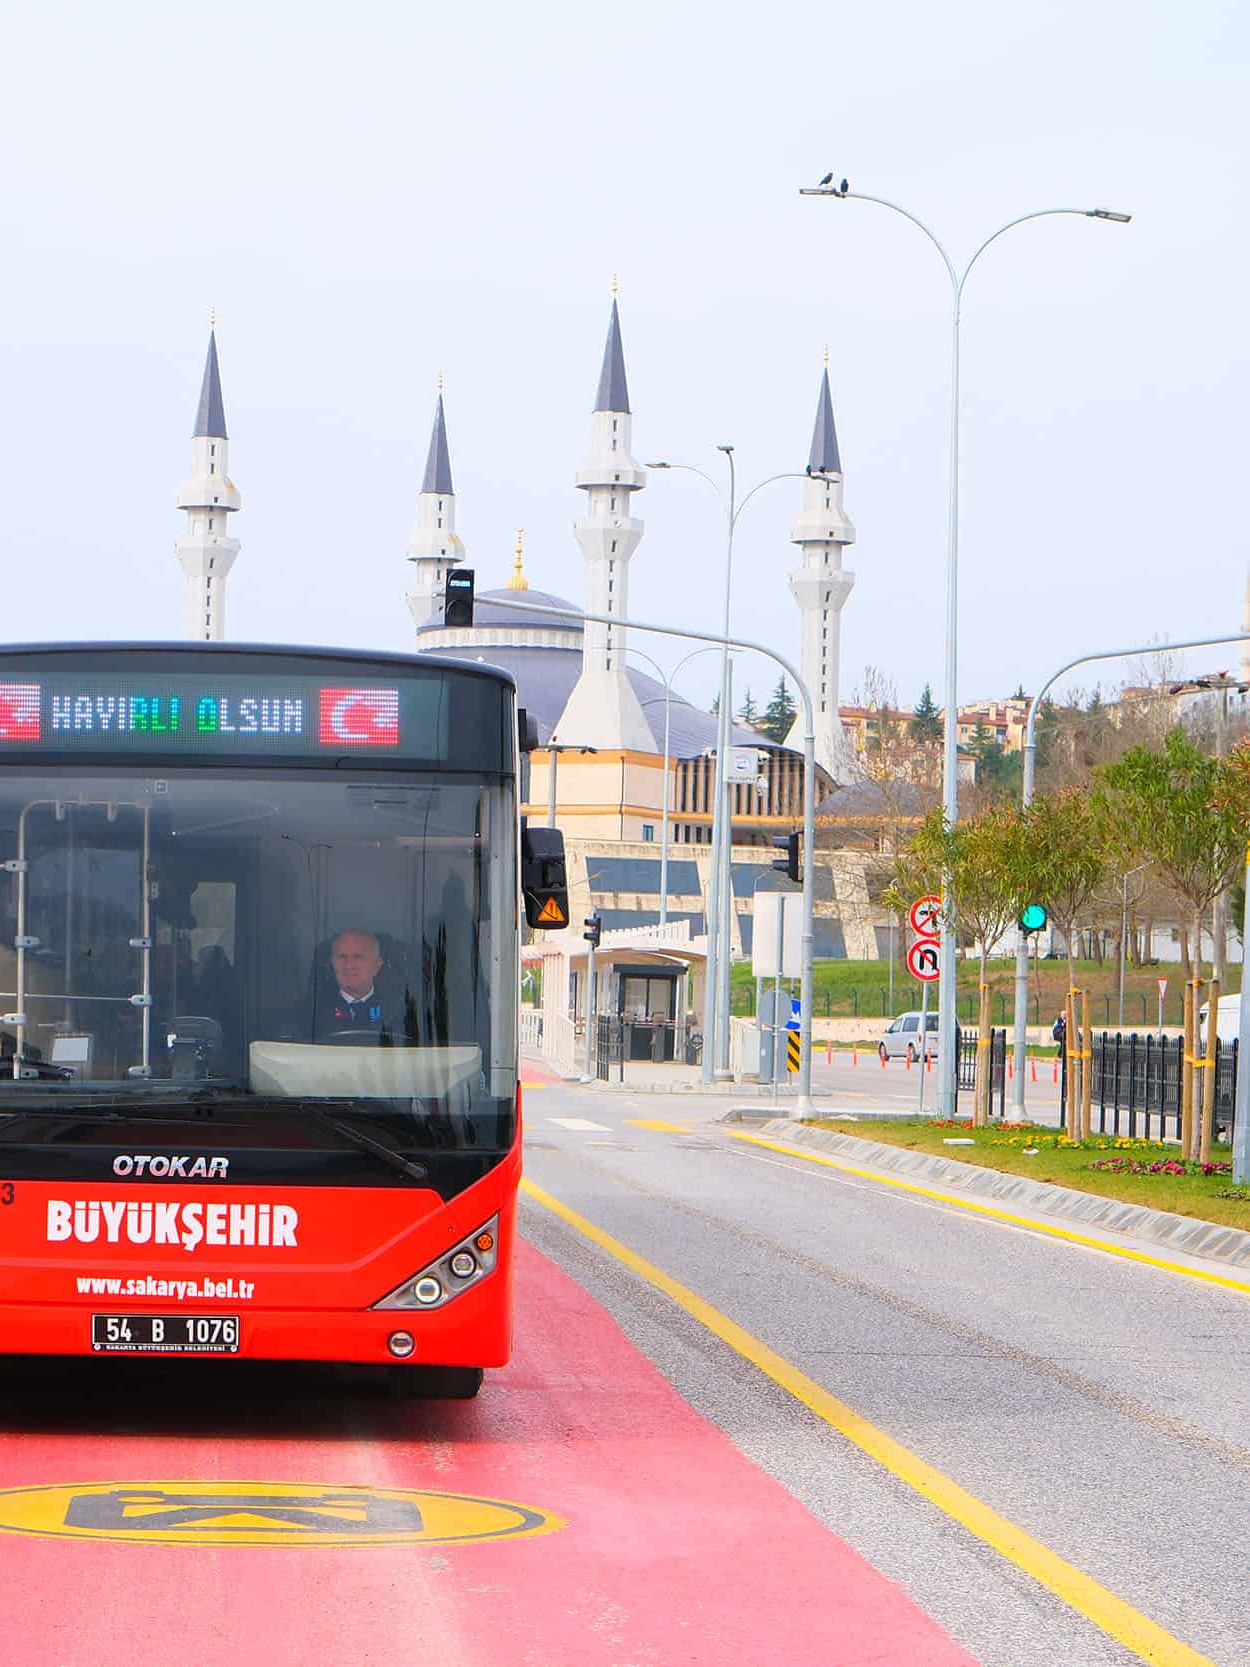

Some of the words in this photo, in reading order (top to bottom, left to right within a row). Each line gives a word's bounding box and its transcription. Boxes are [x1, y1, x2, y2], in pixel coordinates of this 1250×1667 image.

[52, 696, 180, 730] HAYIRLI
[198, 698, 302, 732] OLSUN
[112, 1154, 230, 1178] OTOKAR
[47, 1200, 299, 1252] BÜYÜKŞEHİR
[76, 1276, 255, 1300] www.sakarya.bel.tr
[106, 1317, 133, 1342] 54
[151, 1318, 165, 1343] B
[186, 1319, 236, 1343] 1076
